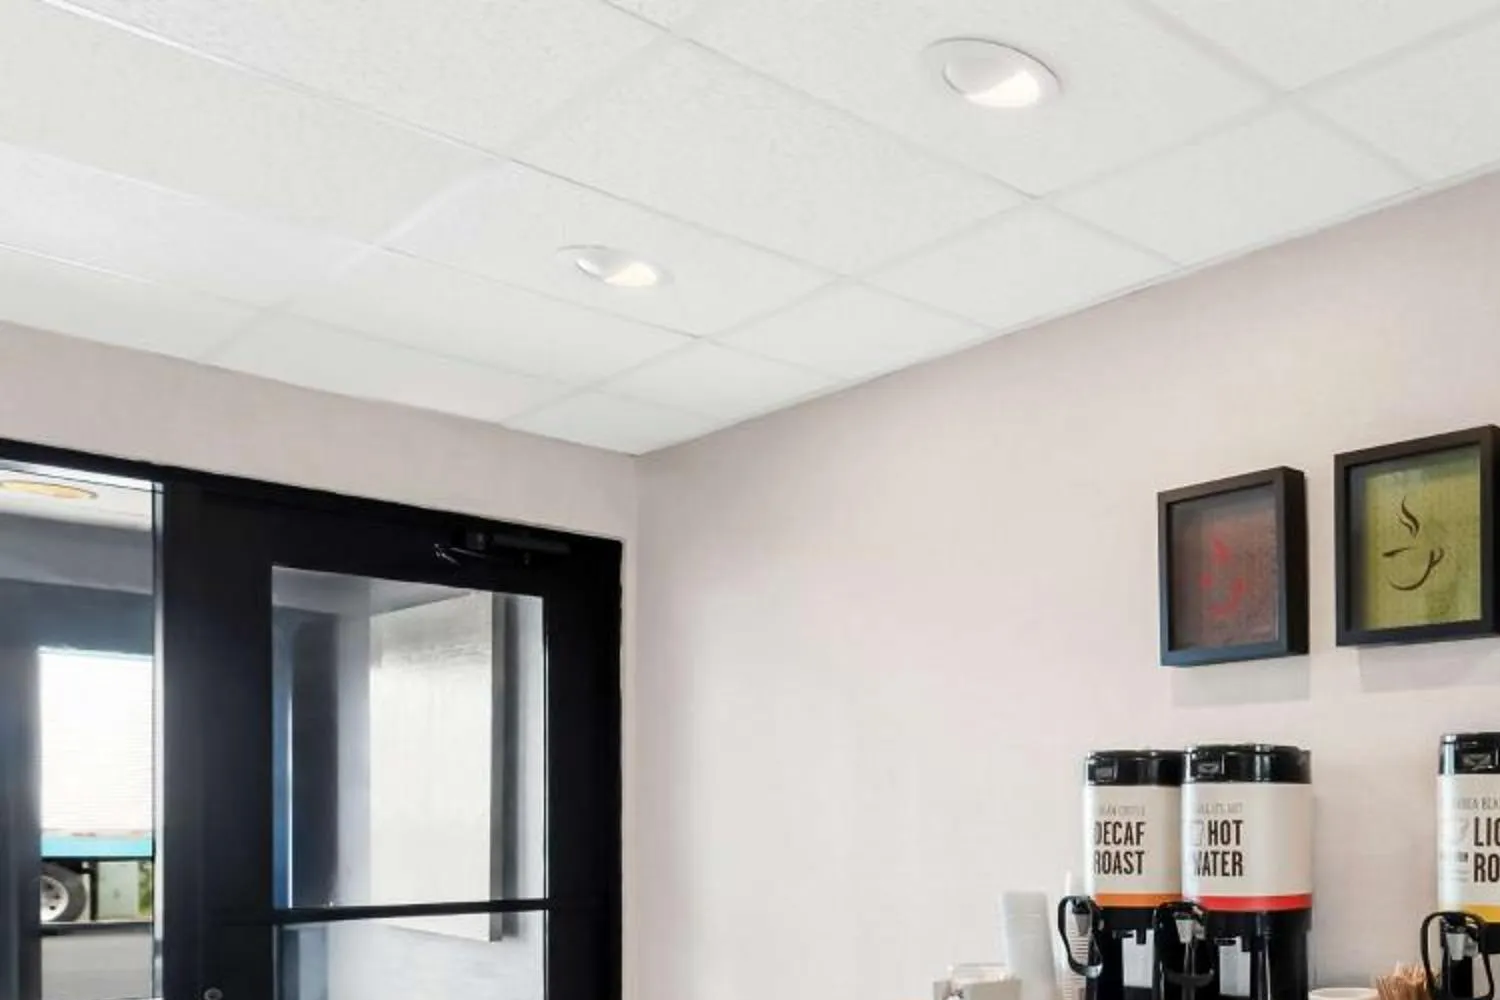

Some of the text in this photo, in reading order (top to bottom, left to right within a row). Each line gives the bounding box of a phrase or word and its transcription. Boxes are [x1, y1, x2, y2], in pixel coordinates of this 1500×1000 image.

[1094, 821, 1146, 846] DECAF
[1207, 819, 1244, 846] HOT
[1094, 850, 1145, 875] ROAST
